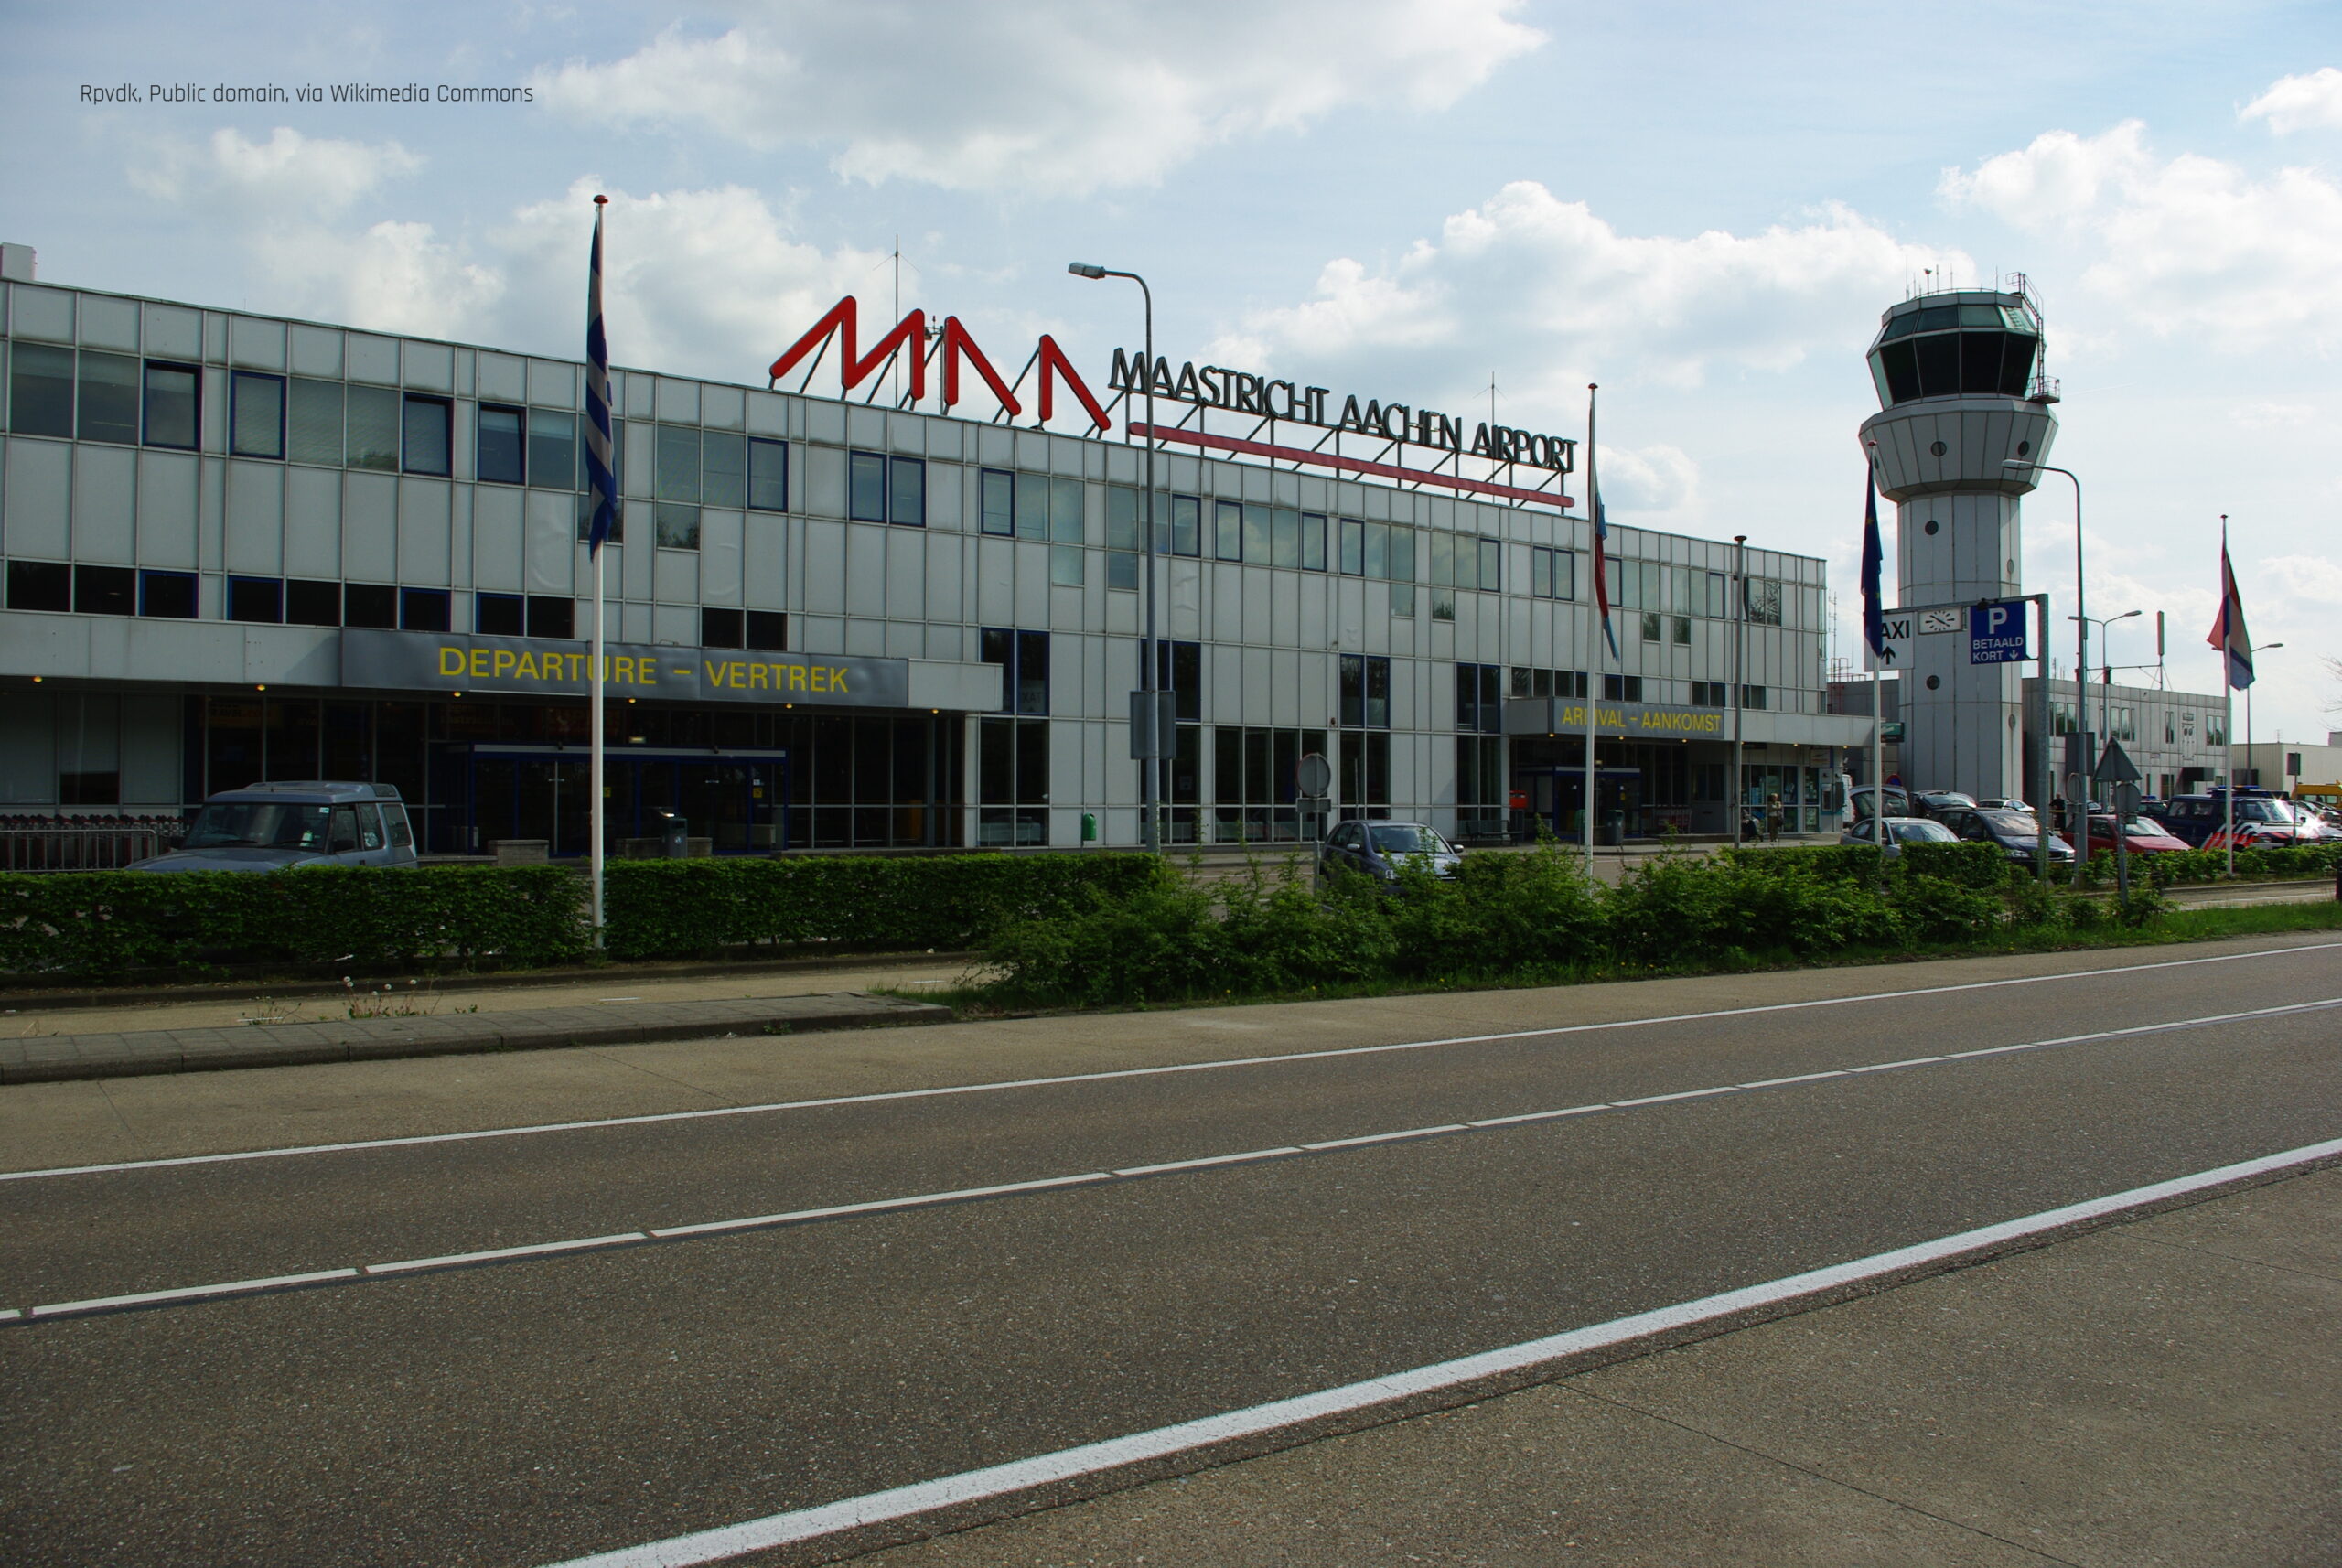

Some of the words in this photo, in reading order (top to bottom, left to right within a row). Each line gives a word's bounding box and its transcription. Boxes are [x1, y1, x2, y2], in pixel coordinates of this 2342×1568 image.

[1107, 347, 1329, 425] MAASTRICHT
[1339, 394, 1463, 454] AACHEN
[1470, 422, 1578, 473] AIRPORT
[1882, 620, 1910, 639] AXI
[1988, 607, 2007, 635] P
[1972, 637, 2024, 650] BETAALD
[1972, 650, 2004, 662] KORT
[439, 647, 658, 684] DEPARTURE
[705, 660, 850, 693] VERTREK
[1562, 706, 1627, 728] ARIVAL
[1641, 712, 1722, 732] AANKOMST
